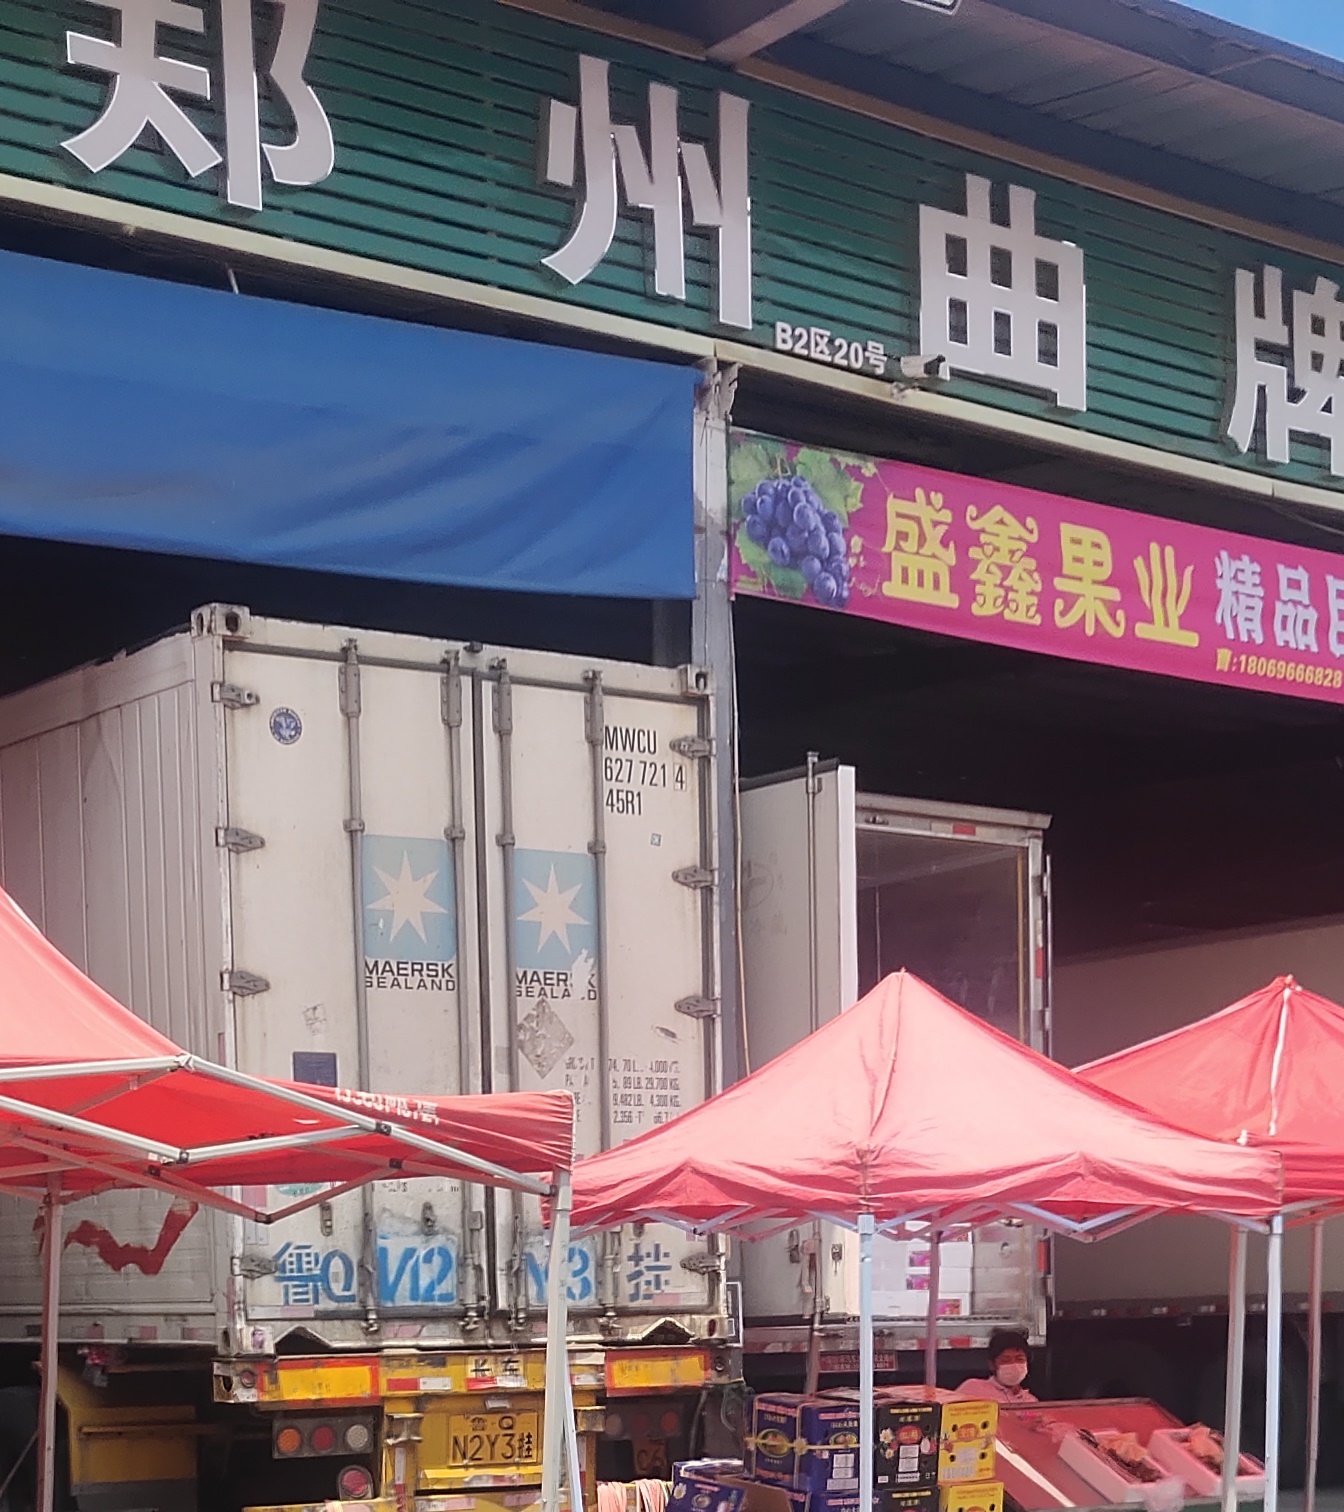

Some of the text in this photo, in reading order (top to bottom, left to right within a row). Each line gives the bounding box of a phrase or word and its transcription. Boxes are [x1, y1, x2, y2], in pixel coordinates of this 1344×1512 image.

[774, 321, 887, 375] B2区20号
[882, 487, 1199, 648] 盛鑫果业
[604, 726, 657, 755] MWCU
[604, 757, 685, 791] 627 721 4
[606, 789, 642, 816] 45R1
[365, 960, 455, 979] MAERSK
[365, 976, 456, 991] SEALAND
[516, 970, 597, 989] MAERK
[516, 986, 598, 1001] SEALAD
[451, 1432, 534, 1462] N2Y3挂
